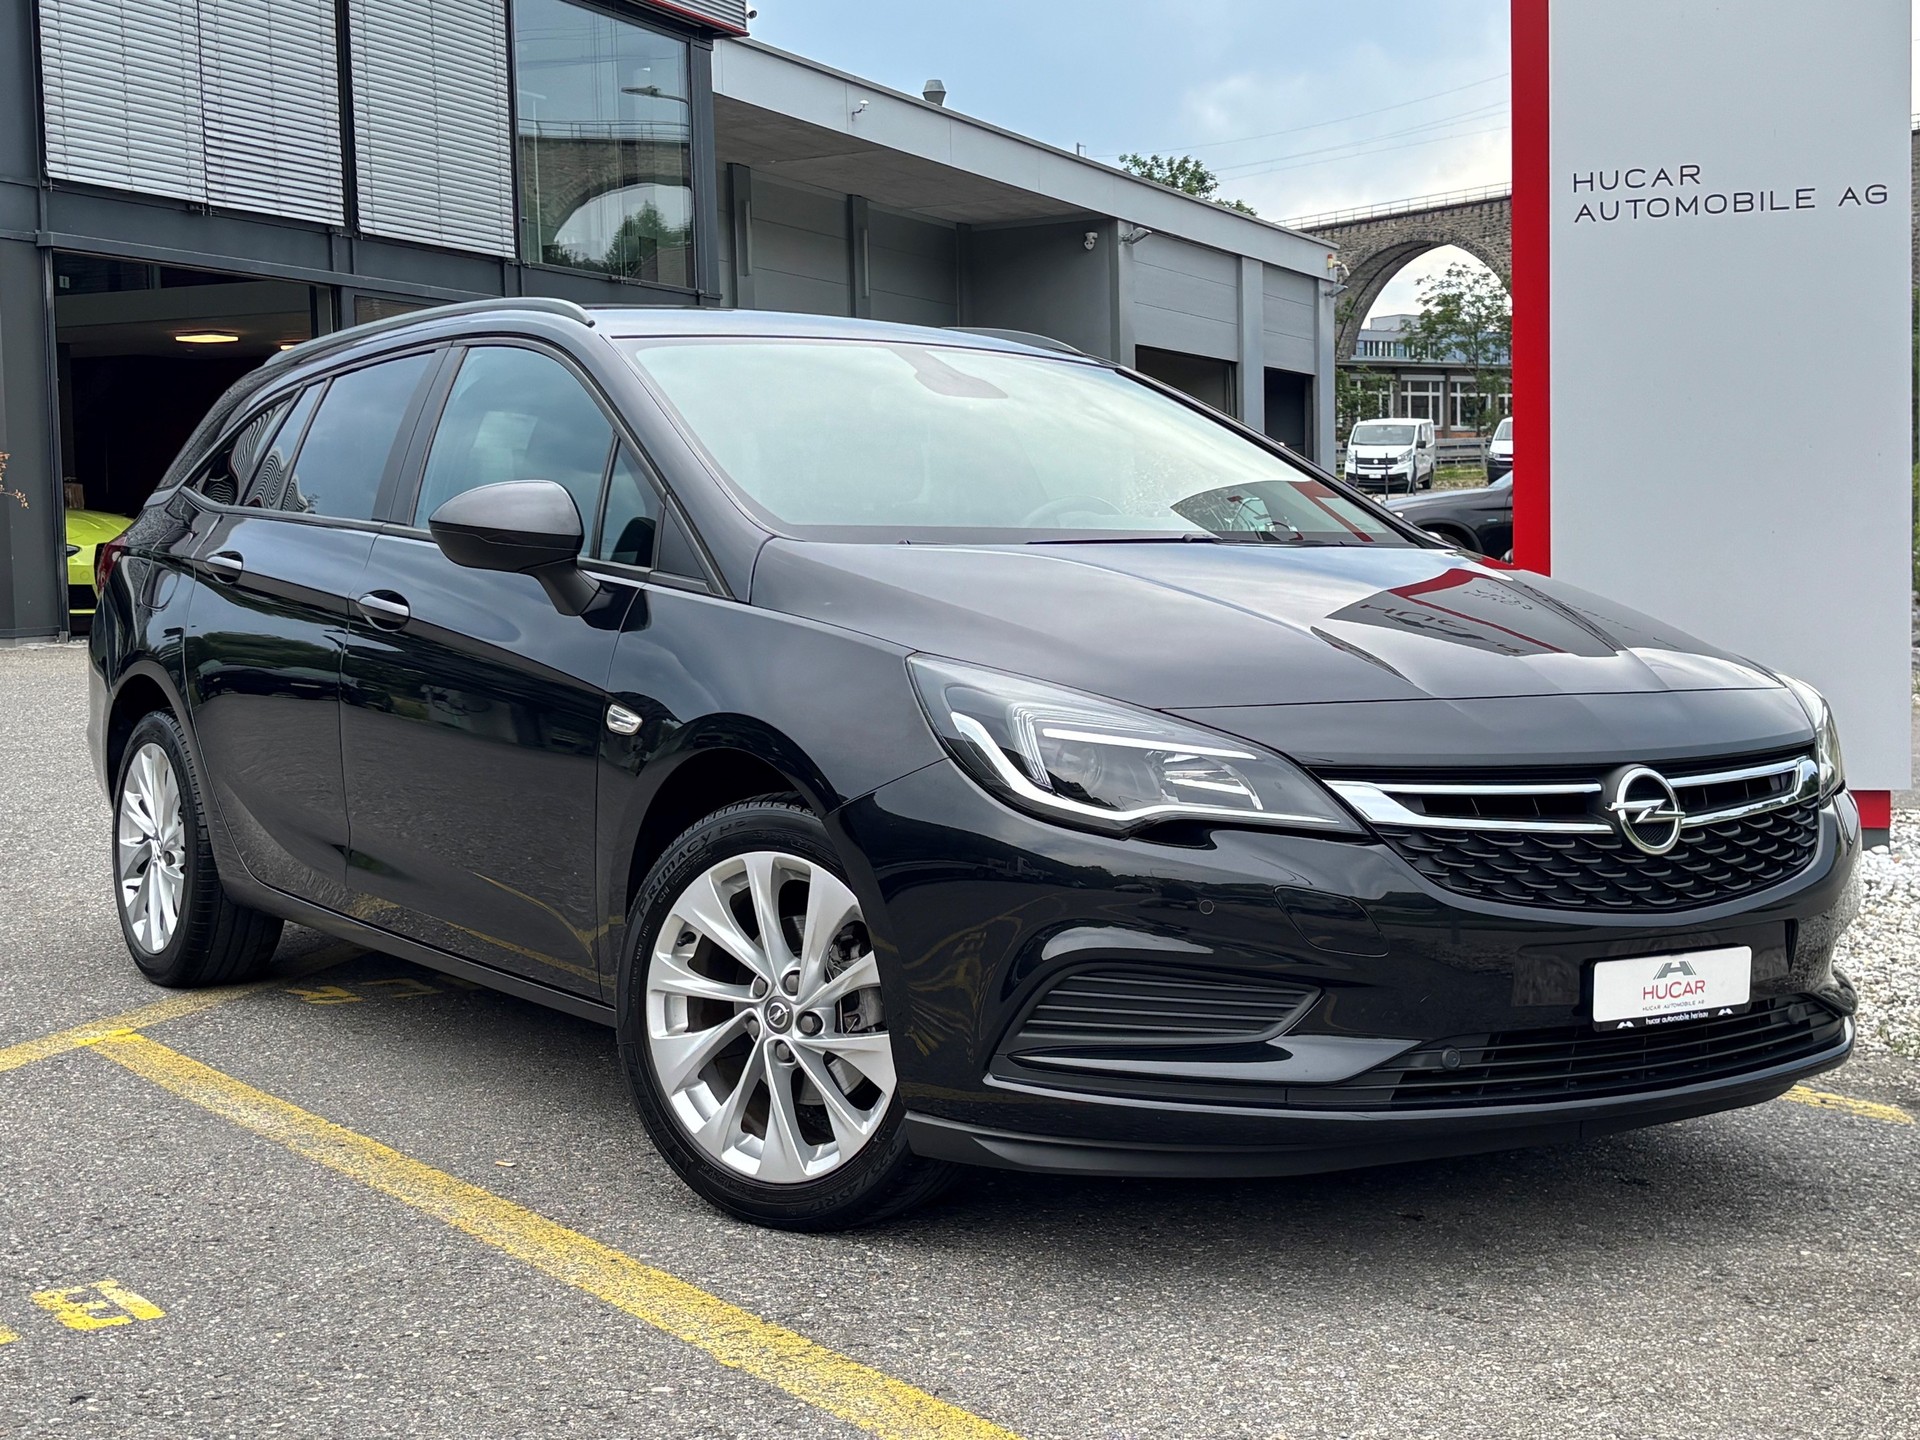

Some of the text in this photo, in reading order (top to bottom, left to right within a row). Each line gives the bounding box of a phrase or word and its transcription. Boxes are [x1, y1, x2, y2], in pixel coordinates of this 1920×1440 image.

[1573, 164, 1701, 193] HUCAR
[1574, 184, 1888, 223] AUTOMOBILE AG
[638, 831, 712, 918] PRIMACY
[1642, 979, 1706, 1000] HUCAR
[1642, 1004, 1661, 1012] HUCAR
[1663, 1000, 1696, 1009] AUTOMOBILE
[1645, 1011, 1709, 1025] hucar automobile herisau
